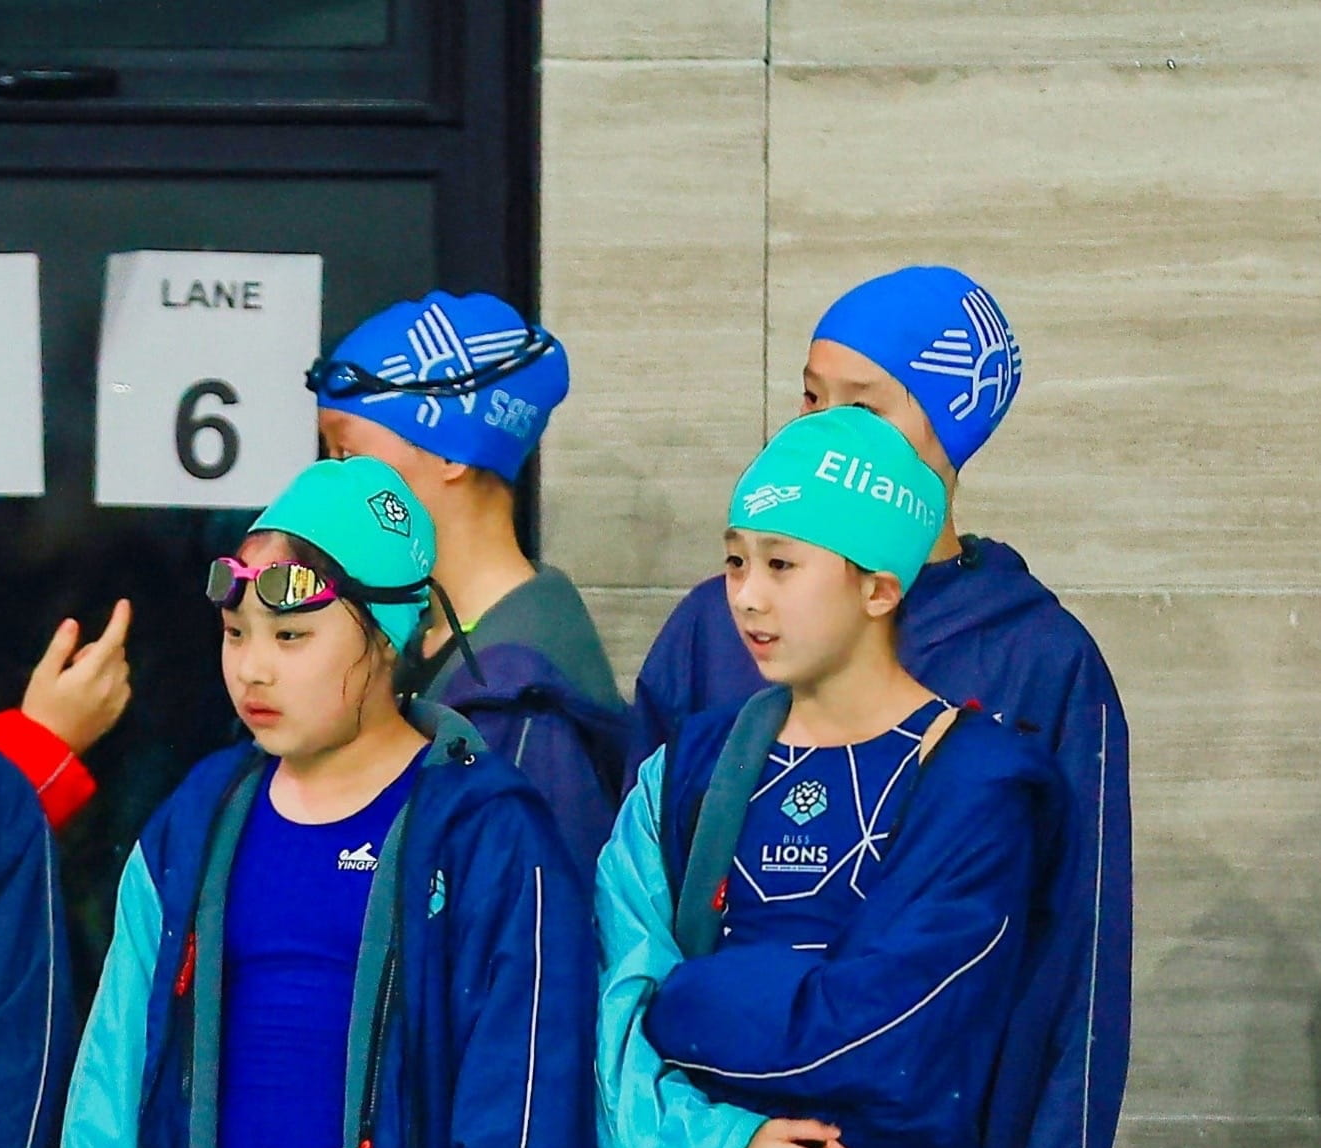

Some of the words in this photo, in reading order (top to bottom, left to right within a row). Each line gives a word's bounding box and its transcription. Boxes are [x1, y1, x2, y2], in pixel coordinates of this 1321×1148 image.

[161, 279, 262, 311] LANE
[173, 377, 242, 481] 6
[761, 845, 828, 864] LIONS
